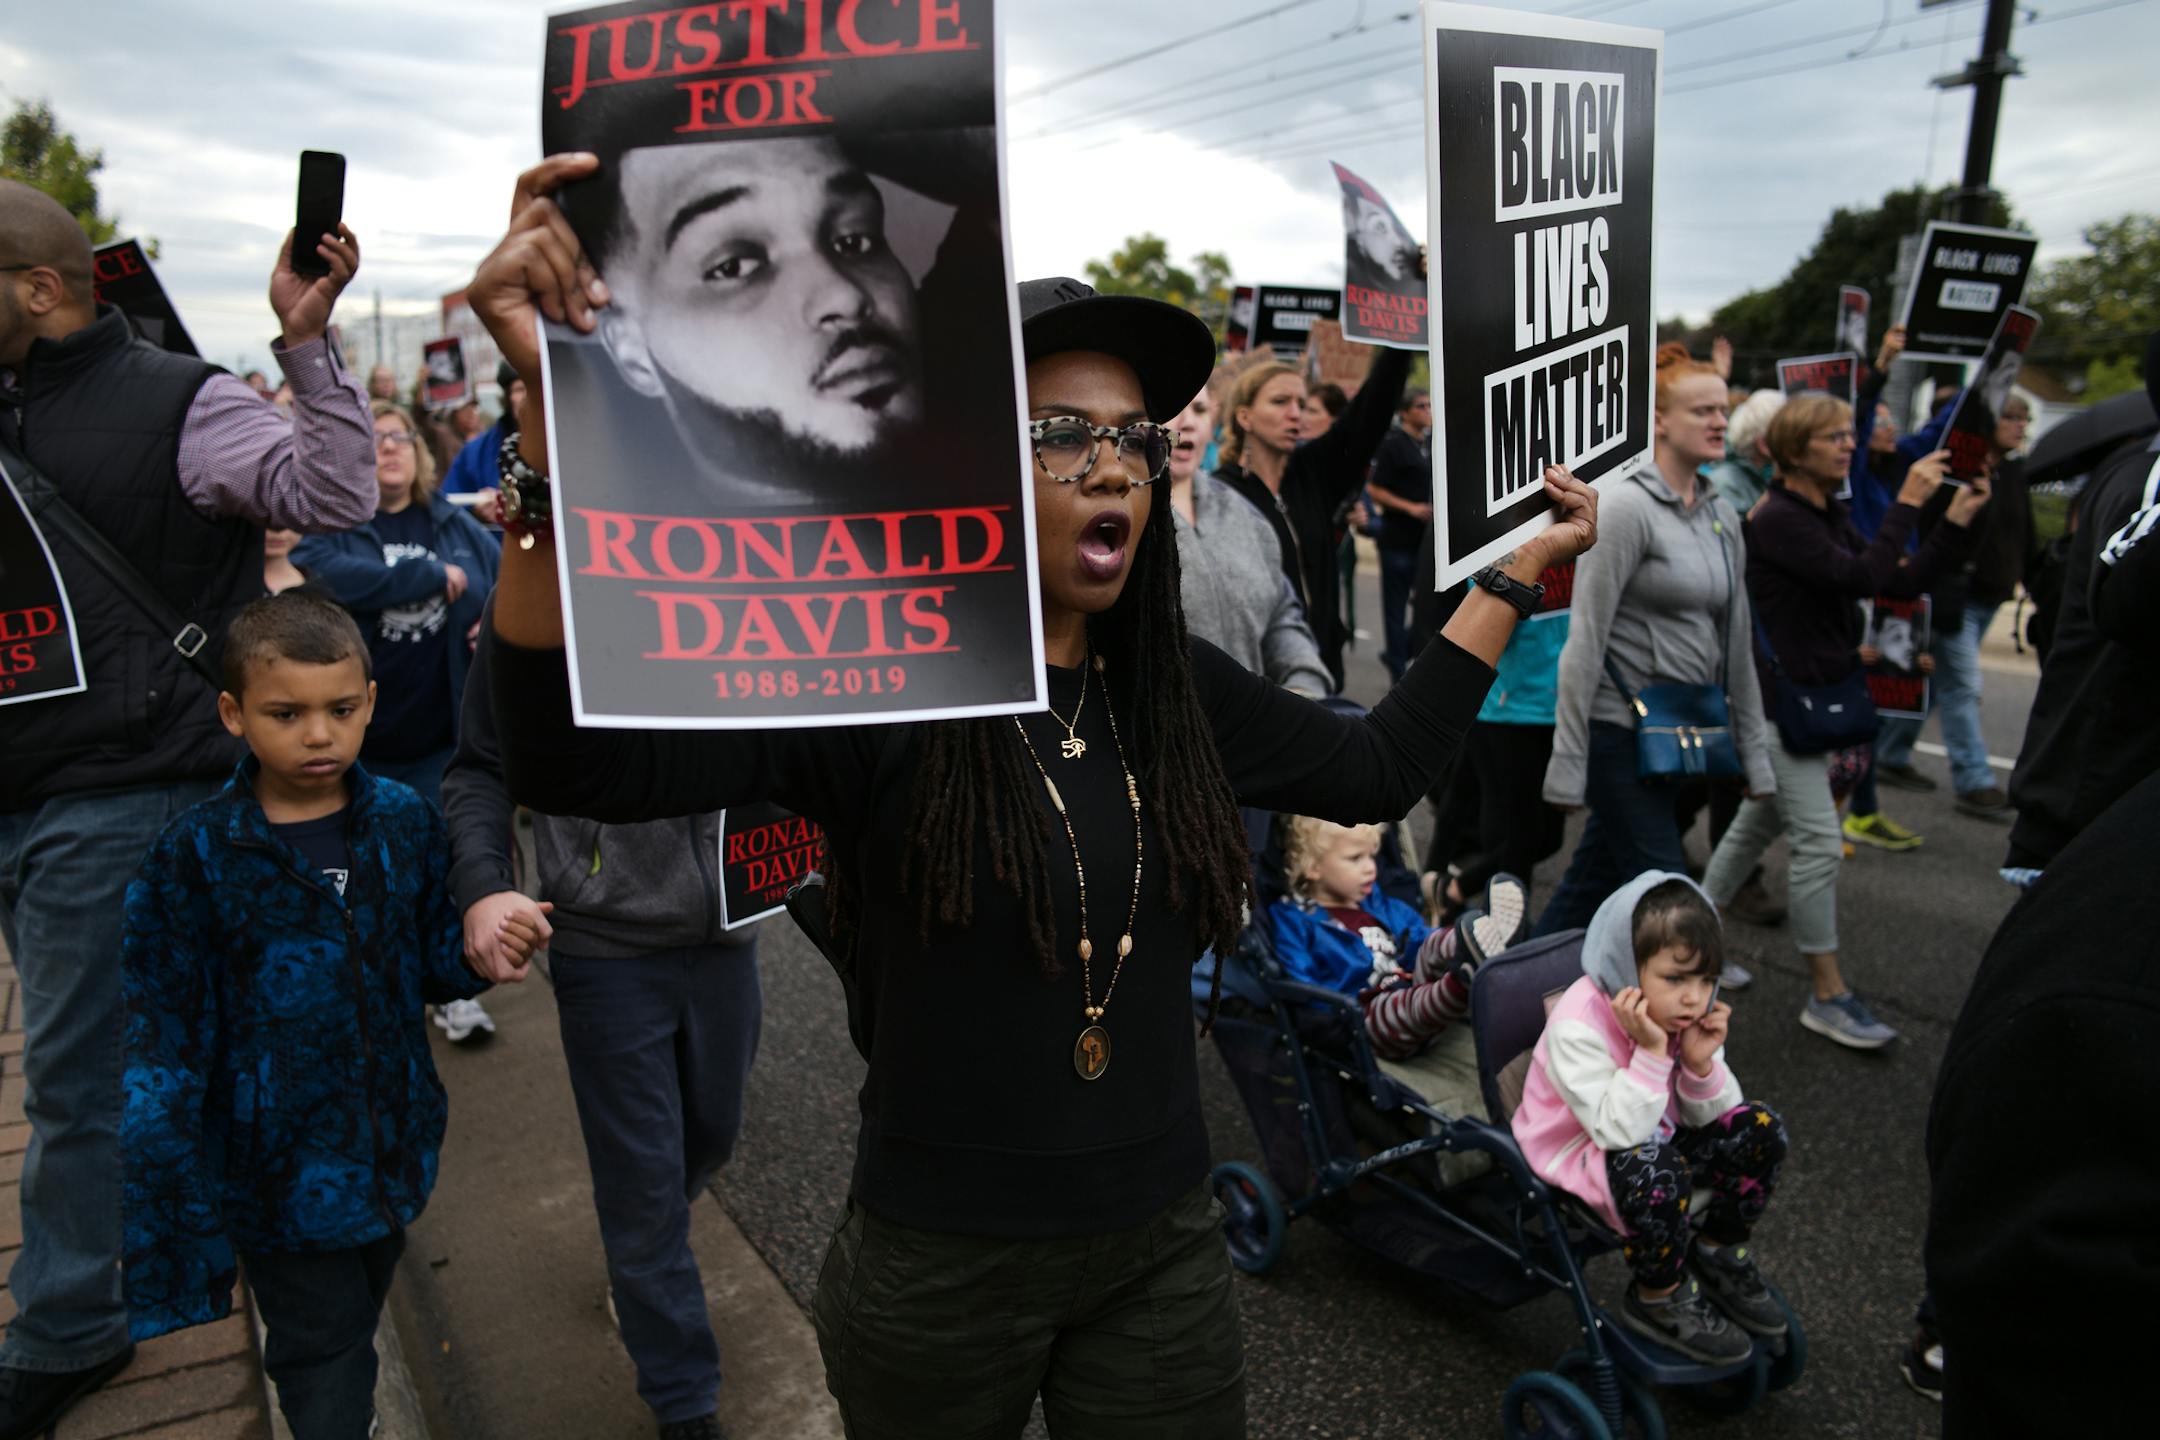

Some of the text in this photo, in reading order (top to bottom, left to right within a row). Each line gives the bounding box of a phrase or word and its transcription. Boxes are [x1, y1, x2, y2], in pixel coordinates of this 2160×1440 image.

[554, 0, 970, 109] JUSTICE
[678, 73, 833, 132] FOR
[1500, 80, 1621, 208] BLACK
[1346, 283, 1429, 317] RONALD
[1357, 307, 1421, 335] DAVIS
[1513, 215, 1610, 353] LIVES
[1490, 337, 1625, 503] MATTER
[573, 506, 1012, 583] RONALD
[643, 587, 957, 660] DAVIS
[712, 665, 907, 699] 1988-2019
